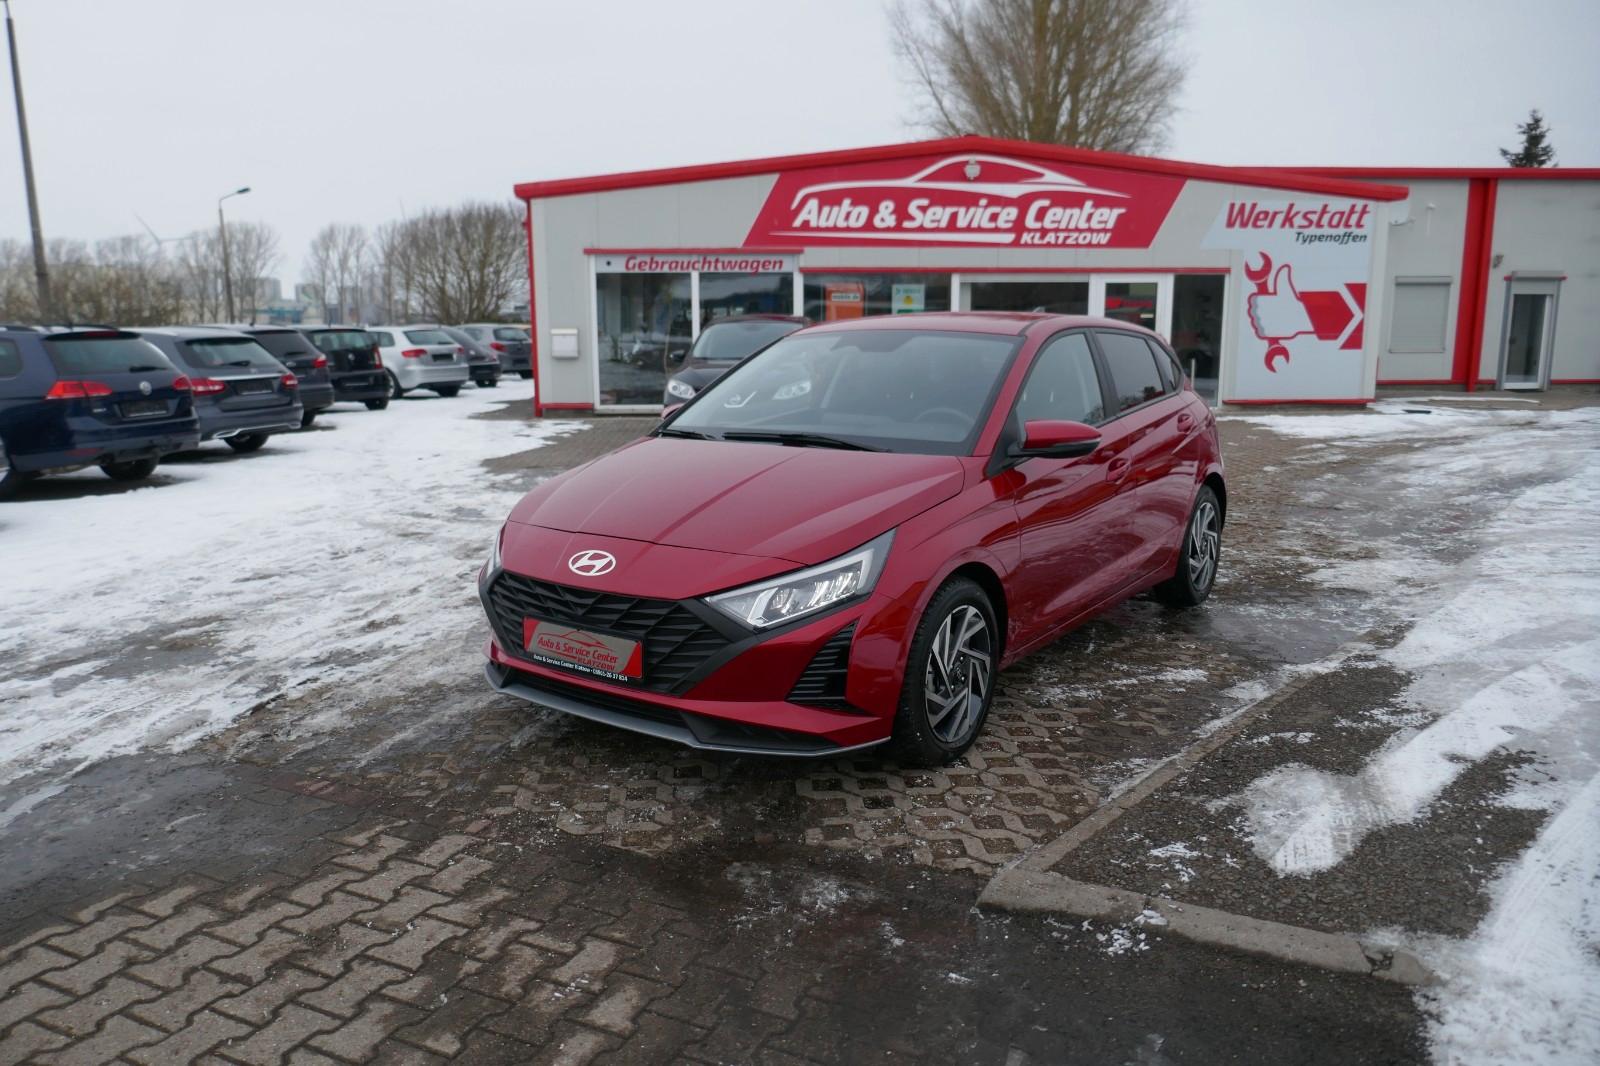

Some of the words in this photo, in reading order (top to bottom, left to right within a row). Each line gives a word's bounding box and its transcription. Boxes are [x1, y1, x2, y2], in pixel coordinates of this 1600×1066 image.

[792, 197, 870, 228] Auto
[872, 199, 897, 229] &
[901, 198, 1019, 229] Service
[1024, 199, 1127, 230] Center
[1225, 201, 1370, 230] Werkstatt
[1020, 231, 1112, 245] KLATZOW
[1295, 231, 1368, 245] Typenoffen
[624, 255, 784, 275] Gebrauchtwagen
[537, 636, 554, 649] Auto
[555, 642, 561, 651] &
[563, 643, 591, 658] Service
[592, 650, 619, 663] Center
[547, 657, 560, 666] Service
